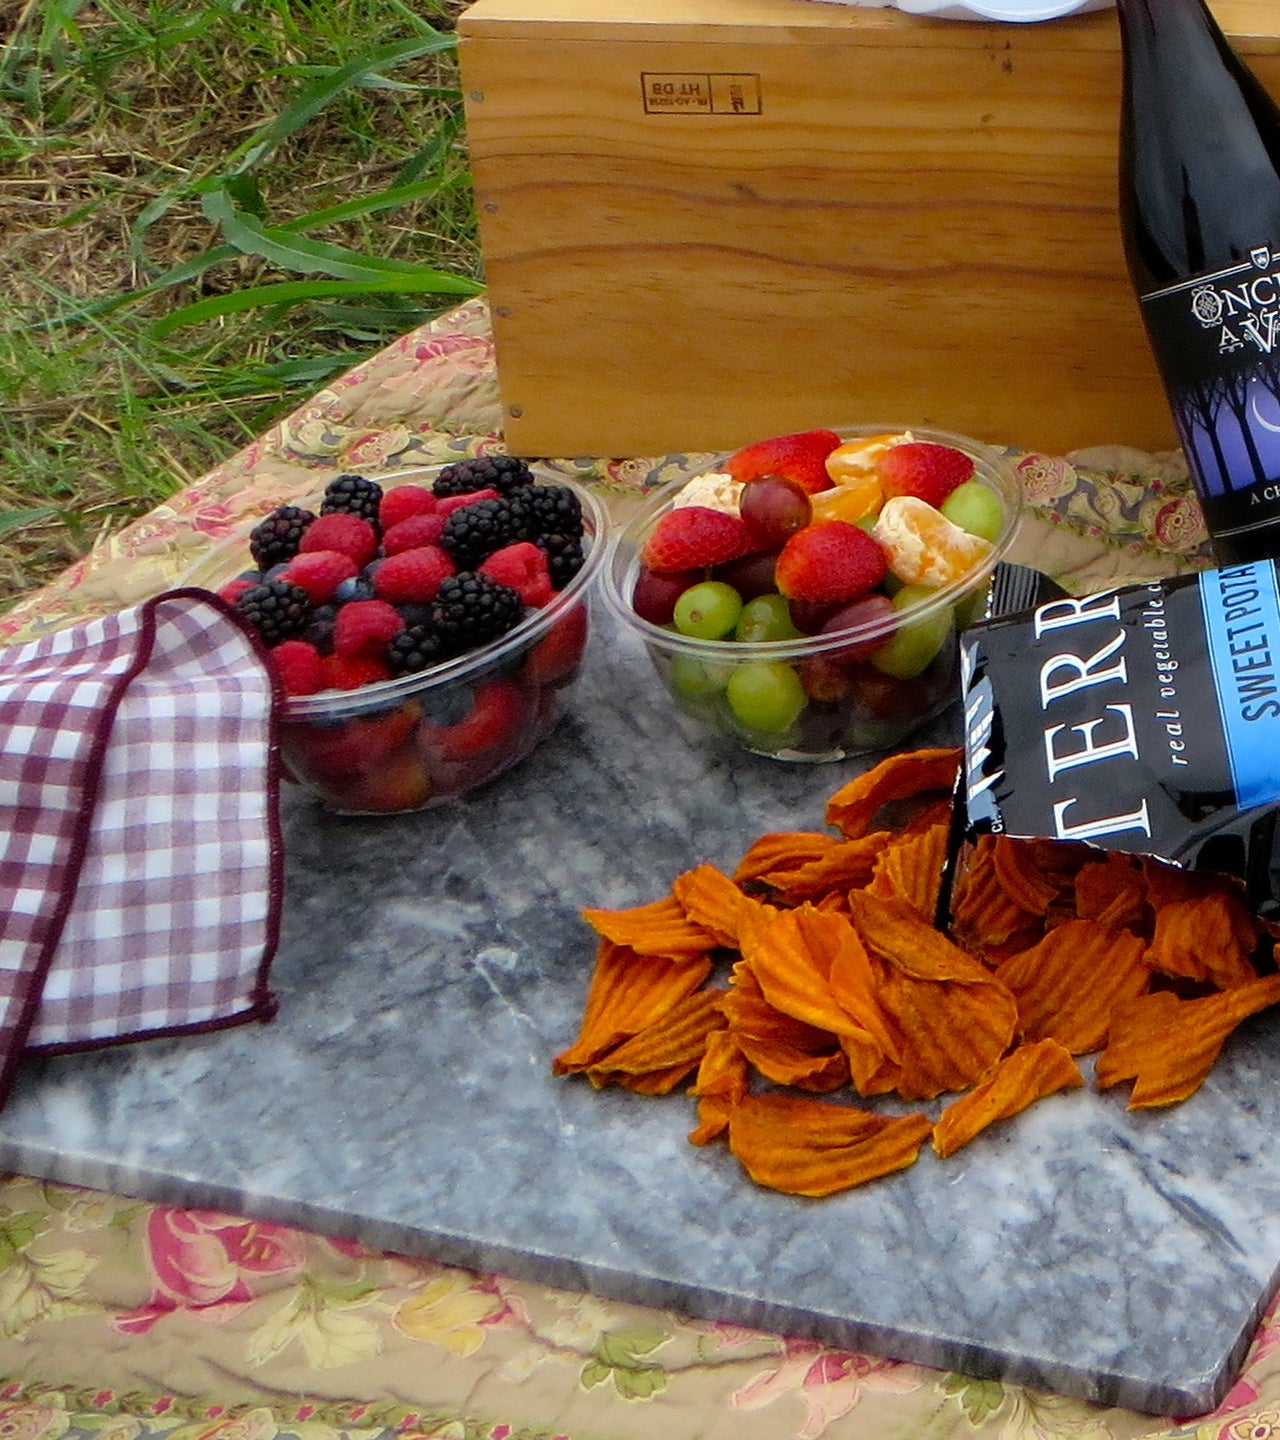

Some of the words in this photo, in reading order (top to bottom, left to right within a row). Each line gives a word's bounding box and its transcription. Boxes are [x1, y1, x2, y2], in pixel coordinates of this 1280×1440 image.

[1218, 325, 1241, 350] A
[1250, 492, 1261, 506] A
[1218, 562, 1263, 623] POTA
[1141, 598, 1180, 700] vegetable
[1155, 709, 1189, 767] real
